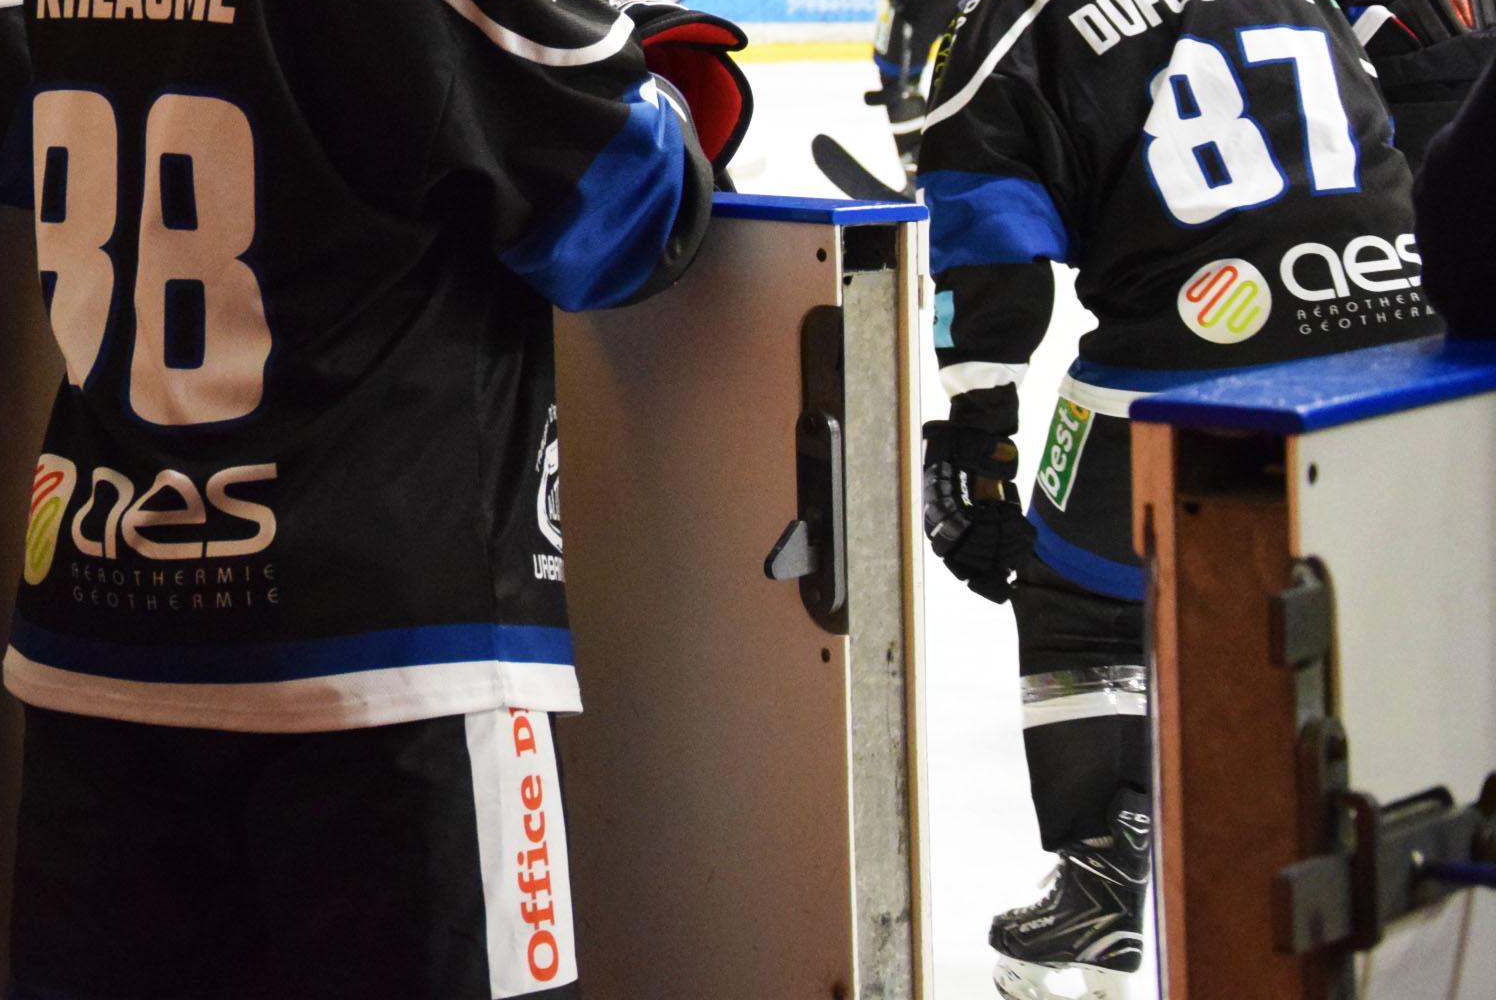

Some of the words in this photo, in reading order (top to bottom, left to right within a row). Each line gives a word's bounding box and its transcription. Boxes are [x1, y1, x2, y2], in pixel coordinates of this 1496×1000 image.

[1145, 25, 1360, 226] 87
[32, 89, 273, 427] 88
[1280, 234, 1422, 302] aes
[71, 462, 278, 560] aes
[521, 774, 559, 982] Office
